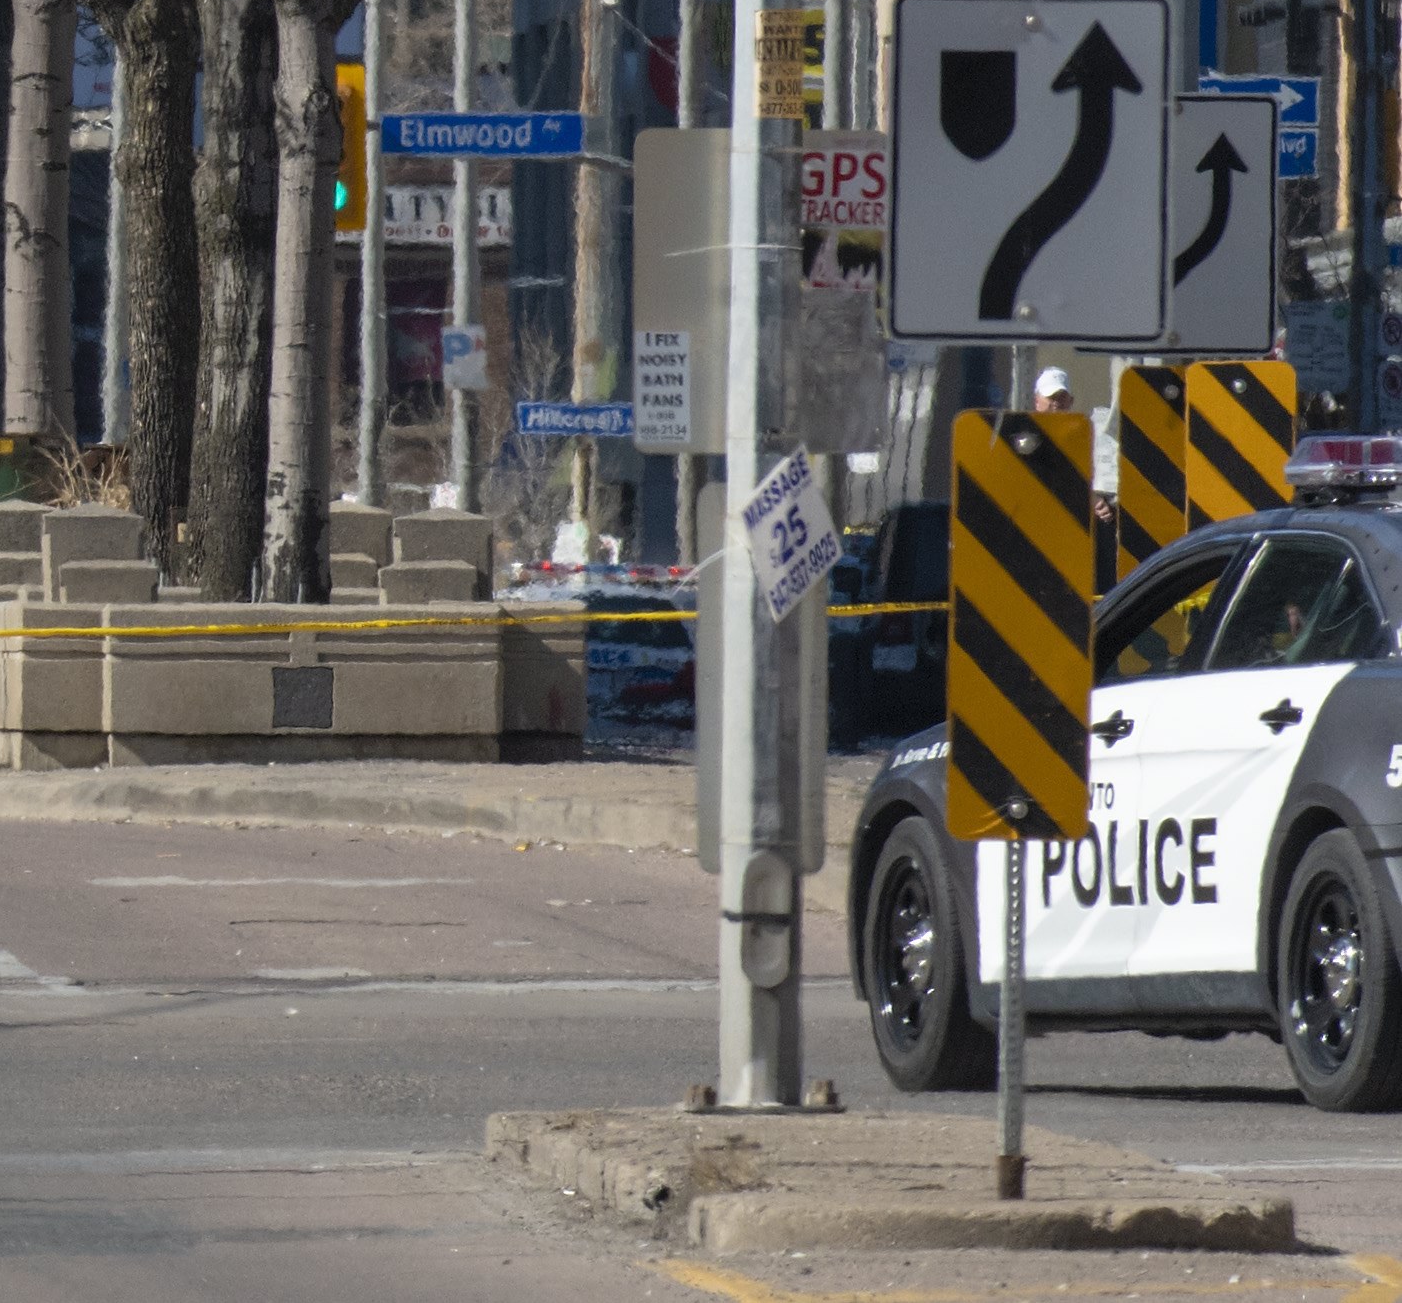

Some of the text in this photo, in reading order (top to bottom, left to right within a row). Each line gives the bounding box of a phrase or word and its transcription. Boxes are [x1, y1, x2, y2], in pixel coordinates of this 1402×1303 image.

[399, 118, 532, 149] Elmwood
[800, 151, 888, 200] GPS
[655, 333, 680, 347] FIX
[639, 353, 687, 367] NOISY
[642, 373, 684, 387] BATH
[642, 394, 684, 407] FANS
[743, 451, 810, 530] MASSAGE
[1042, 816, 1219, 910] POLICE
